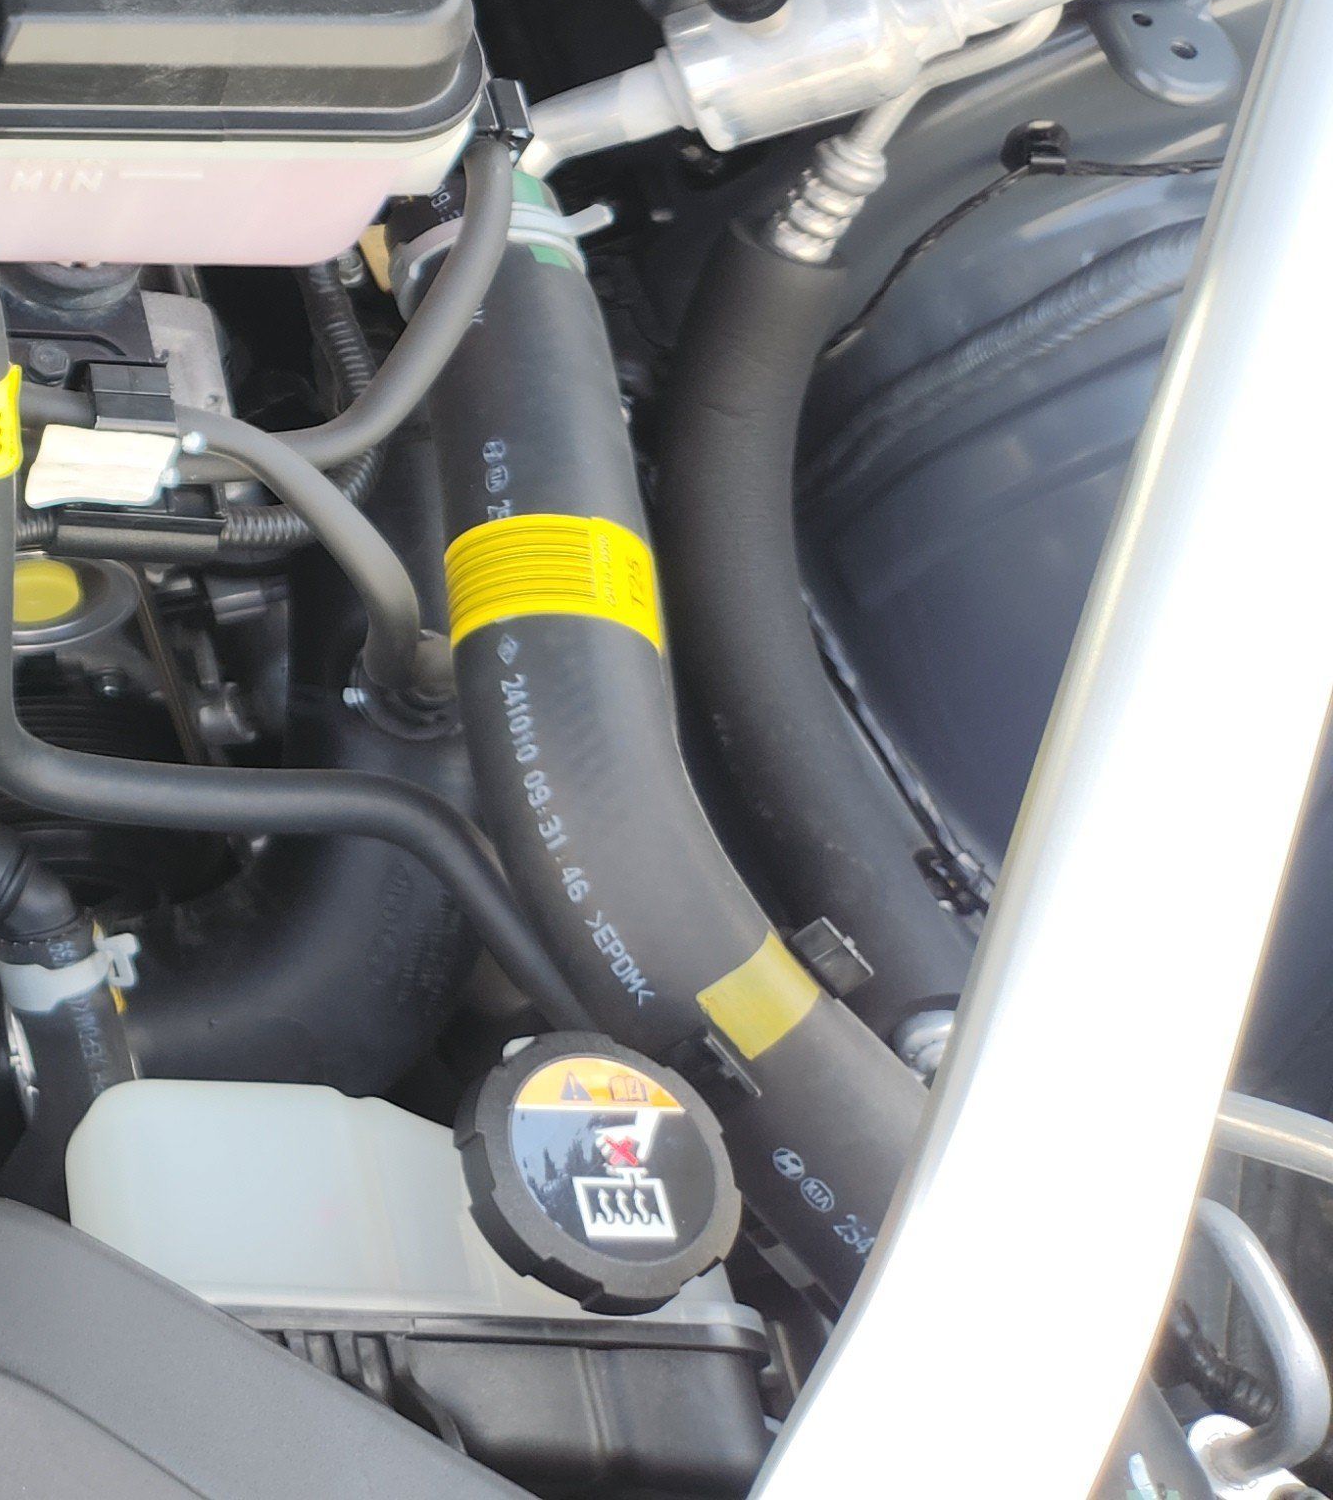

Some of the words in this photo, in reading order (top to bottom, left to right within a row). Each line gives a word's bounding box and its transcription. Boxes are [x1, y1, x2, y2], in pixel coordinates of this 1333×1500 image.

[8, 168, 105, 193] MIN
[626, 555, 646, 608] T25
[499, 672, 541, 764] 241010
[802, 1179, 832, 1211] KIA
[832, 1213, 876, 1254] 254
